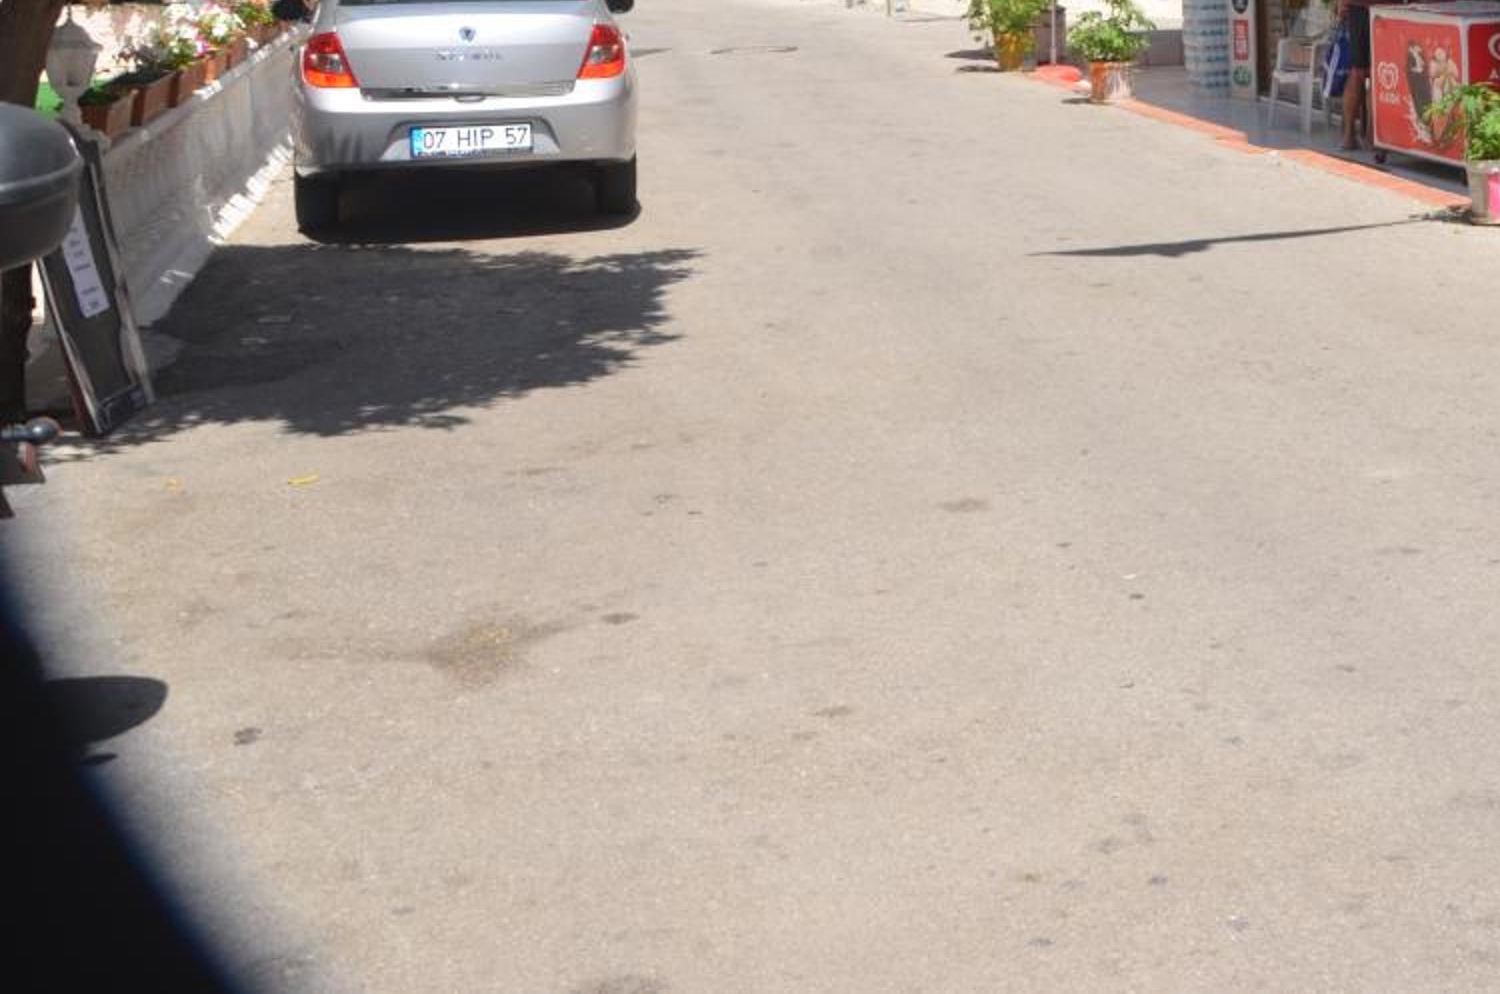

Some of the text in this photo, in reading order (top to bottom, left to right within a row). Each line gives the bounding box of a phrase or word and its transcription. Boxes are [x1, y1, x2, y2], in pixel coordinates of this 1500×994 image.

[423, 126, 528, 149] 07 HIP 57
